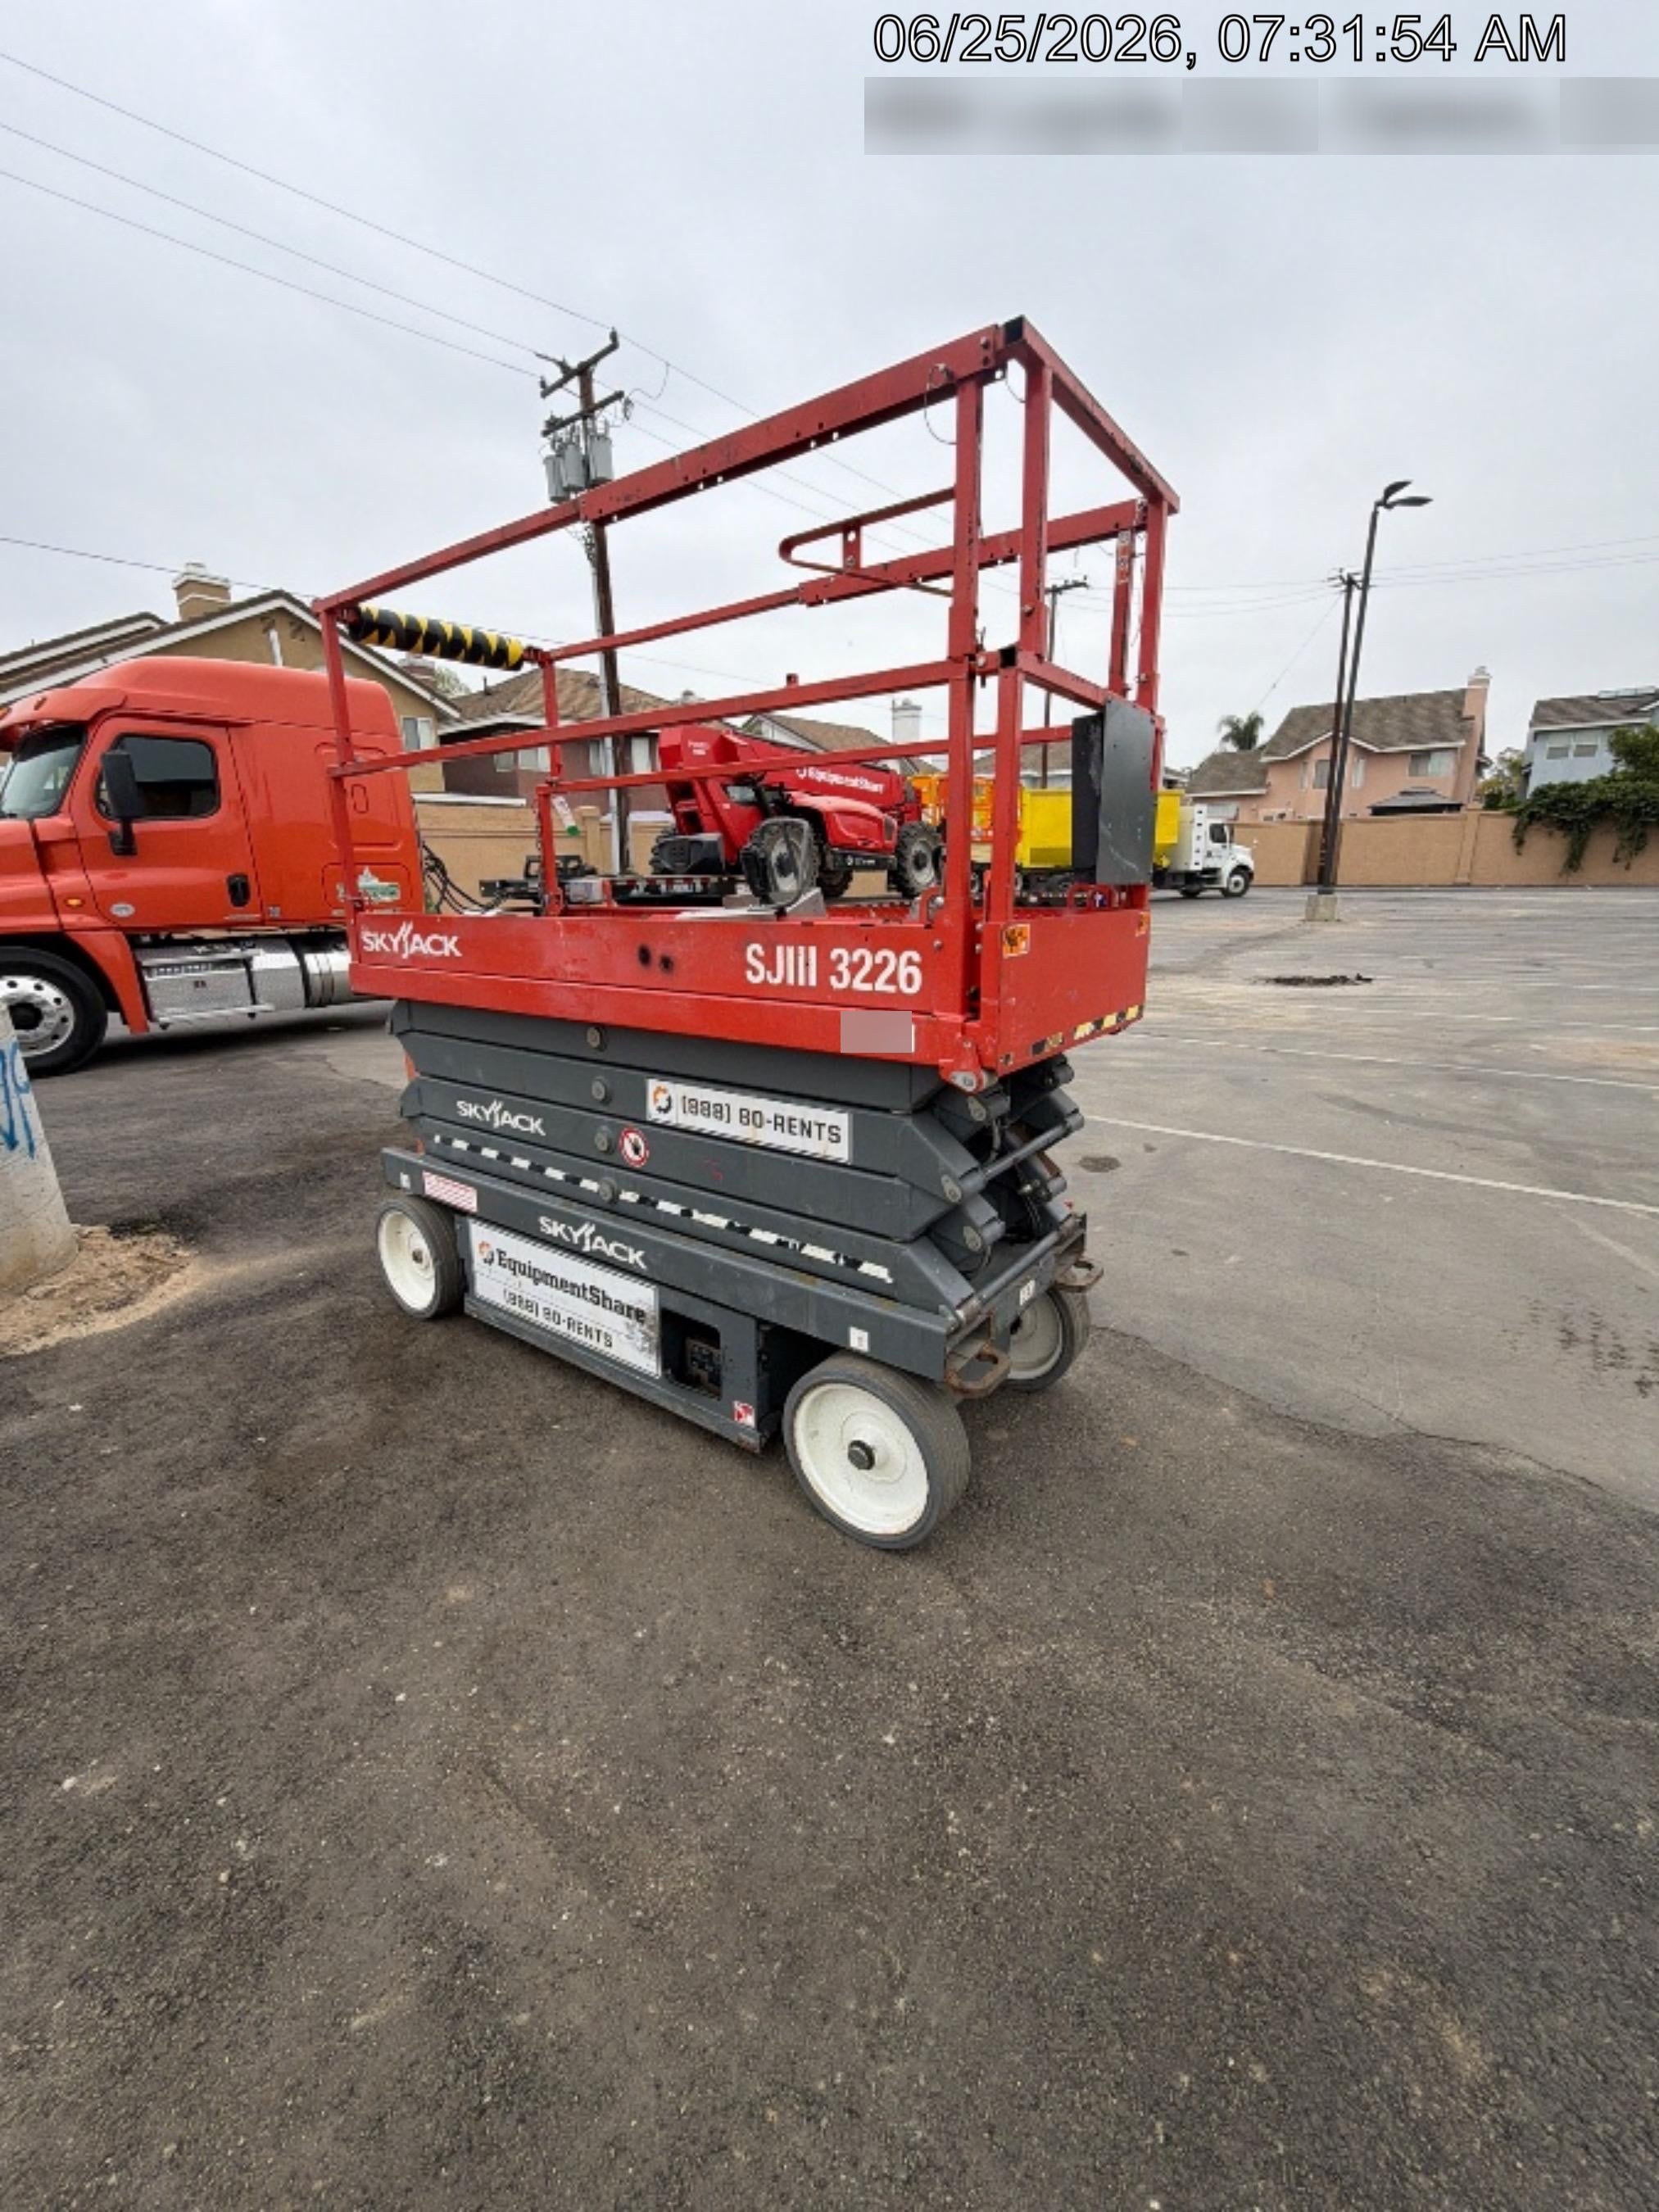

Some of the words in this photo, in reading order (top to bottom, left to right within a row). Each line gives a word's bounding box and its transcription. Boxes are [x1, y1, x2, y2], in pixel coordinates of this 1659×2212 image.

[360, 921, 463, 959] SKYJACK
[746, 943, 818, 987] SJIII
[829, 948, 922, 995] 3226
[456, 1099, 546, 1136] SKYJACK
[538, 1216, 646, 1269] SKYJACK
[496, 1248, 646, 1324] EquipmentShare
